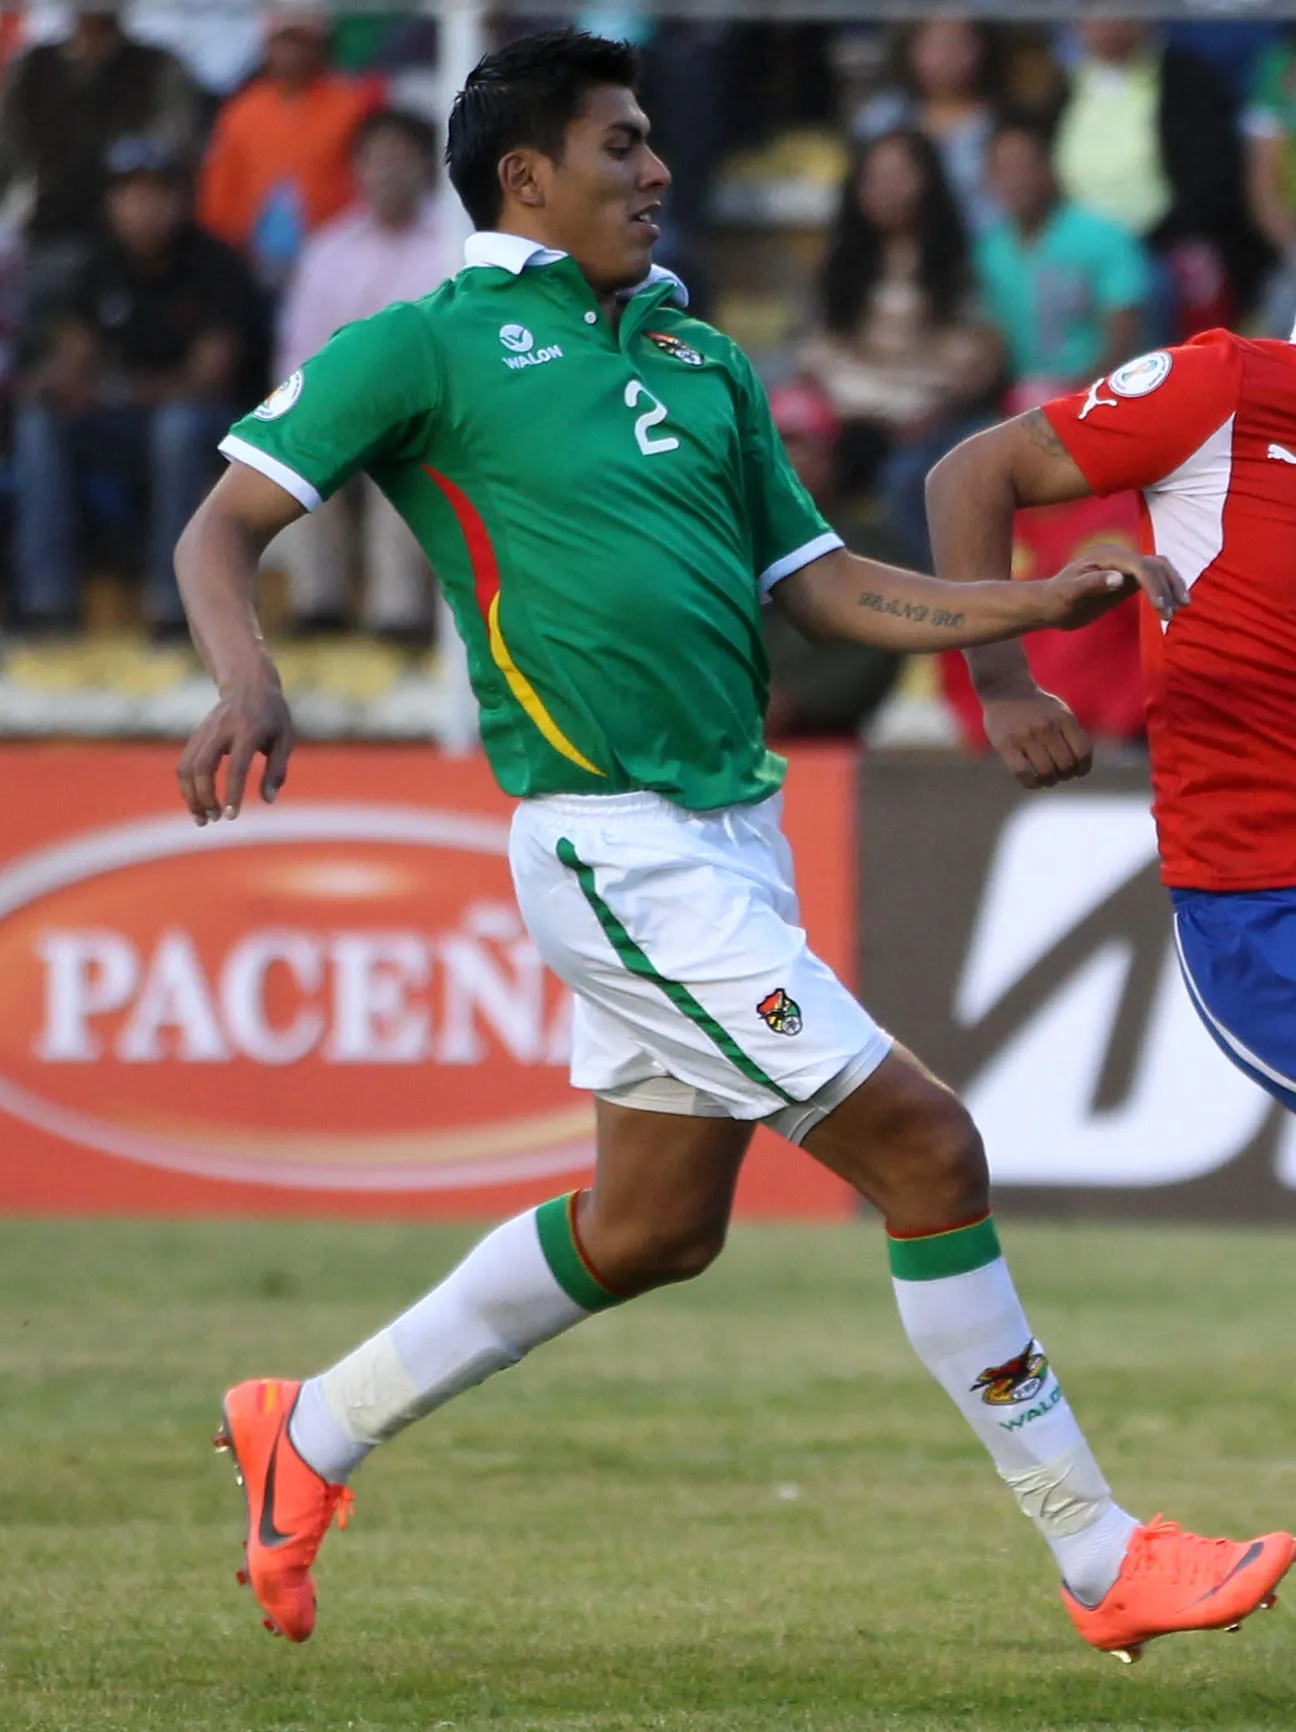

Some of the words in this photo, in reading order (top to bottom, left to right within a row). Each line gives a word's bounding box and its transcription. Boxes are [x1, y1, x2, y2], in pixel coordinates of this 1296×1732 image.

[502, 344, 564, 369] WALON
[624, 379, 680, 456] 2
[35, 903, 574, 1065] PACEÑ
